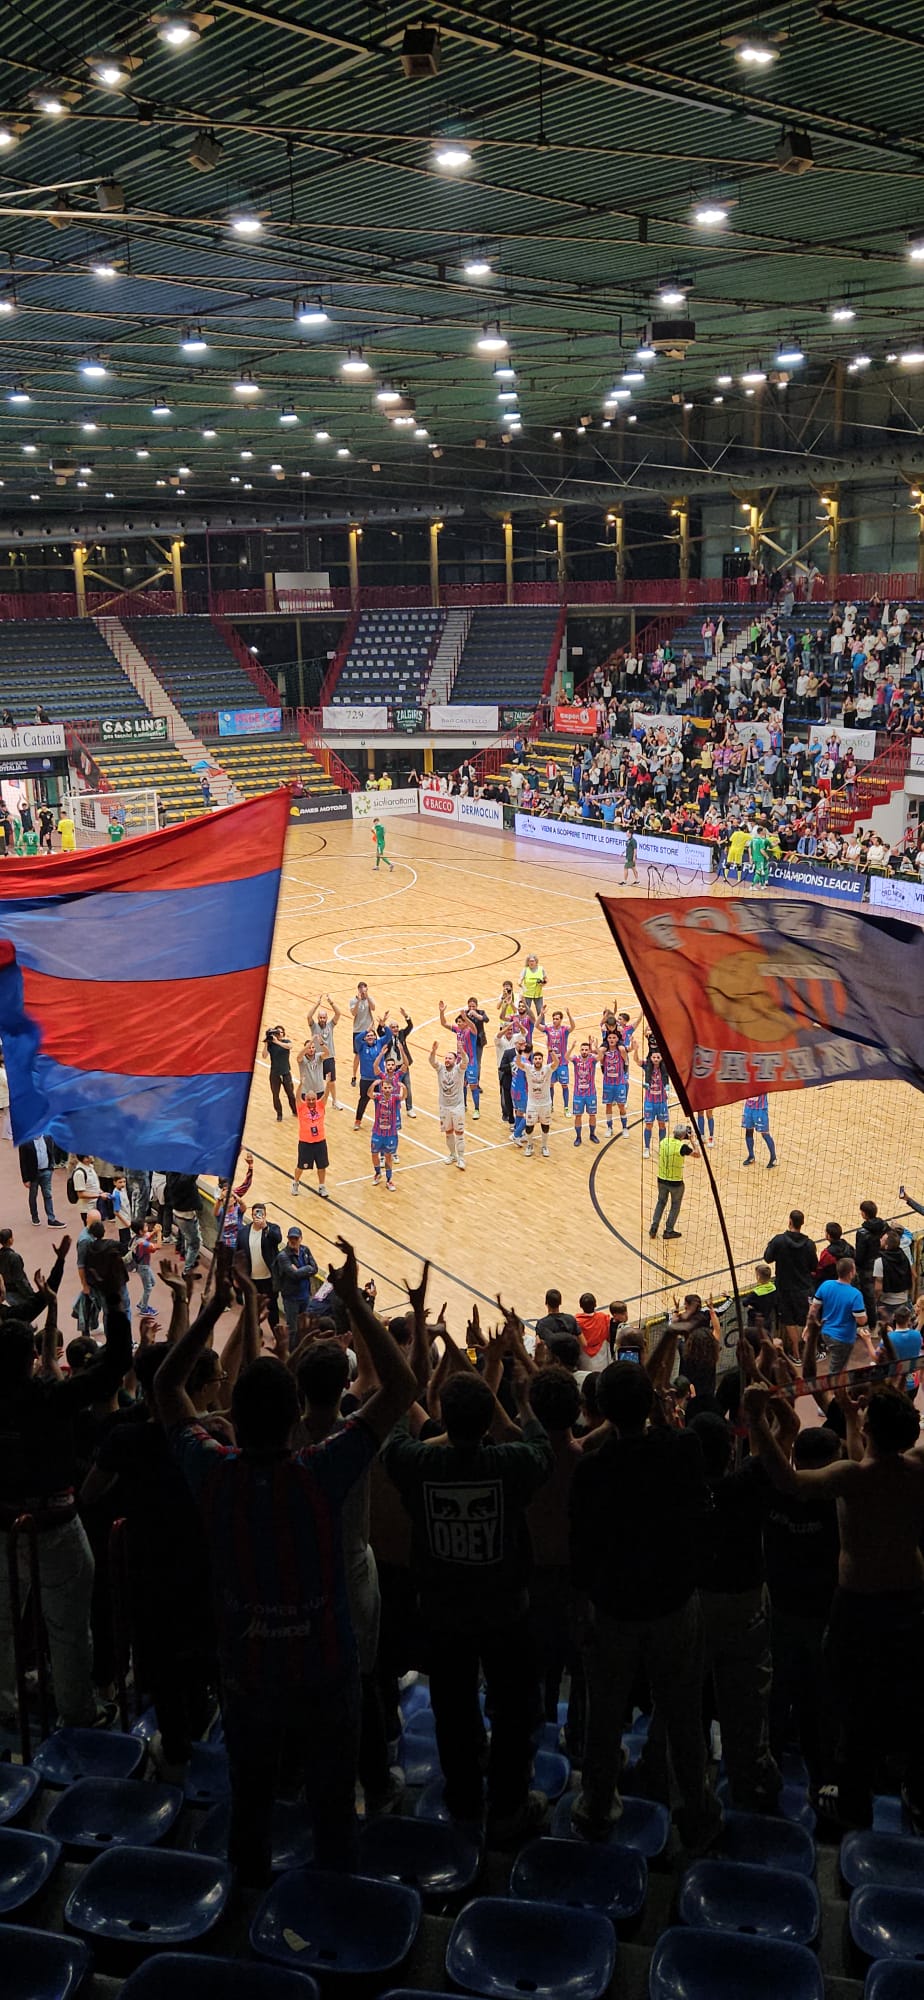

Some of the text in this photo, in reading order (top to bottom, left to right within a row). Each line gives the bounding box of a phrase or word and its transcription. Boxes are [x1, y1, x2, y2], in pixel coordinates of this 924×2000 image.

[102, 720, 132, 733] GAS
[11, 732, 20, 748] di
[23, 731, 61, 747] Catania
[320, 804, 348, 812] MOTORS
[430, 799, 452, 812] BACCO
[461, 804, 499, 820] DERMOCLIN
[582, 833, 597, 842] TUTTE
[598, 835, 604, 843] LE
[639, 843, 658, 853] NOSTRI
[660, 846, 679, 856] STORE
[774, 868, 823, 886] CHAMPIONS
[824, 878, 861, 893] LEAGUE
[434, 1520, 497, 1560] OBEY
